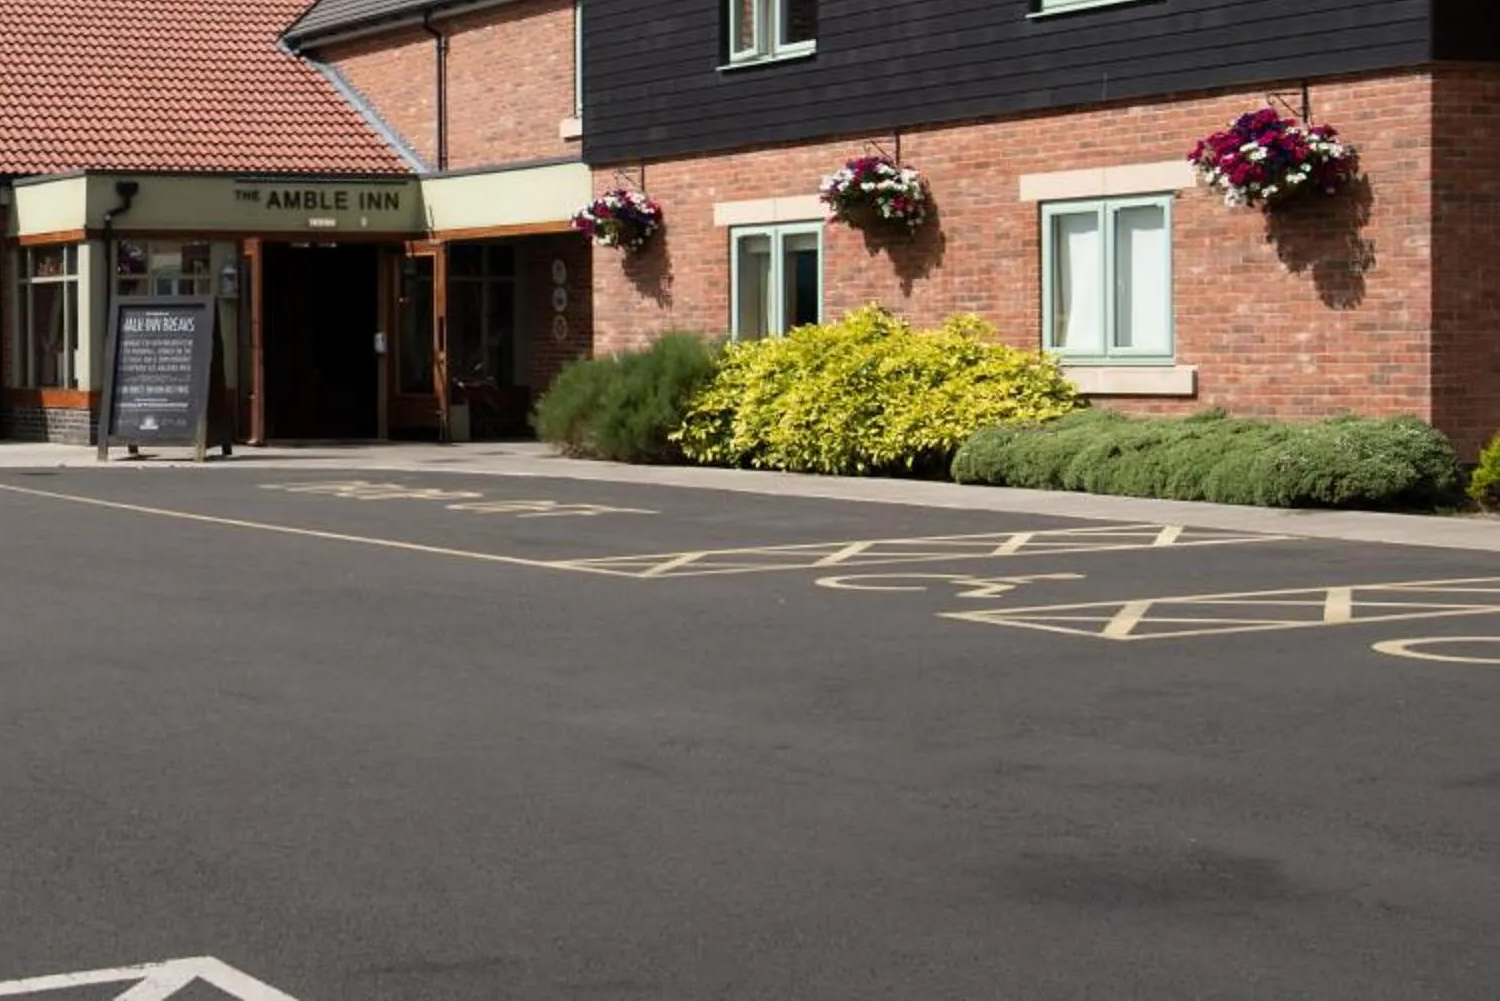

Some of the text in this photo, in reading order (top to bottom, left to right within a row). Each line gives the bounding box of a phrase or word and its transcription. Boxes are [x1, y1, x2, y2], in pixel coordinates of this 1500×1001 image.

[235, 190, 399, 211] THE AMBLE INN
